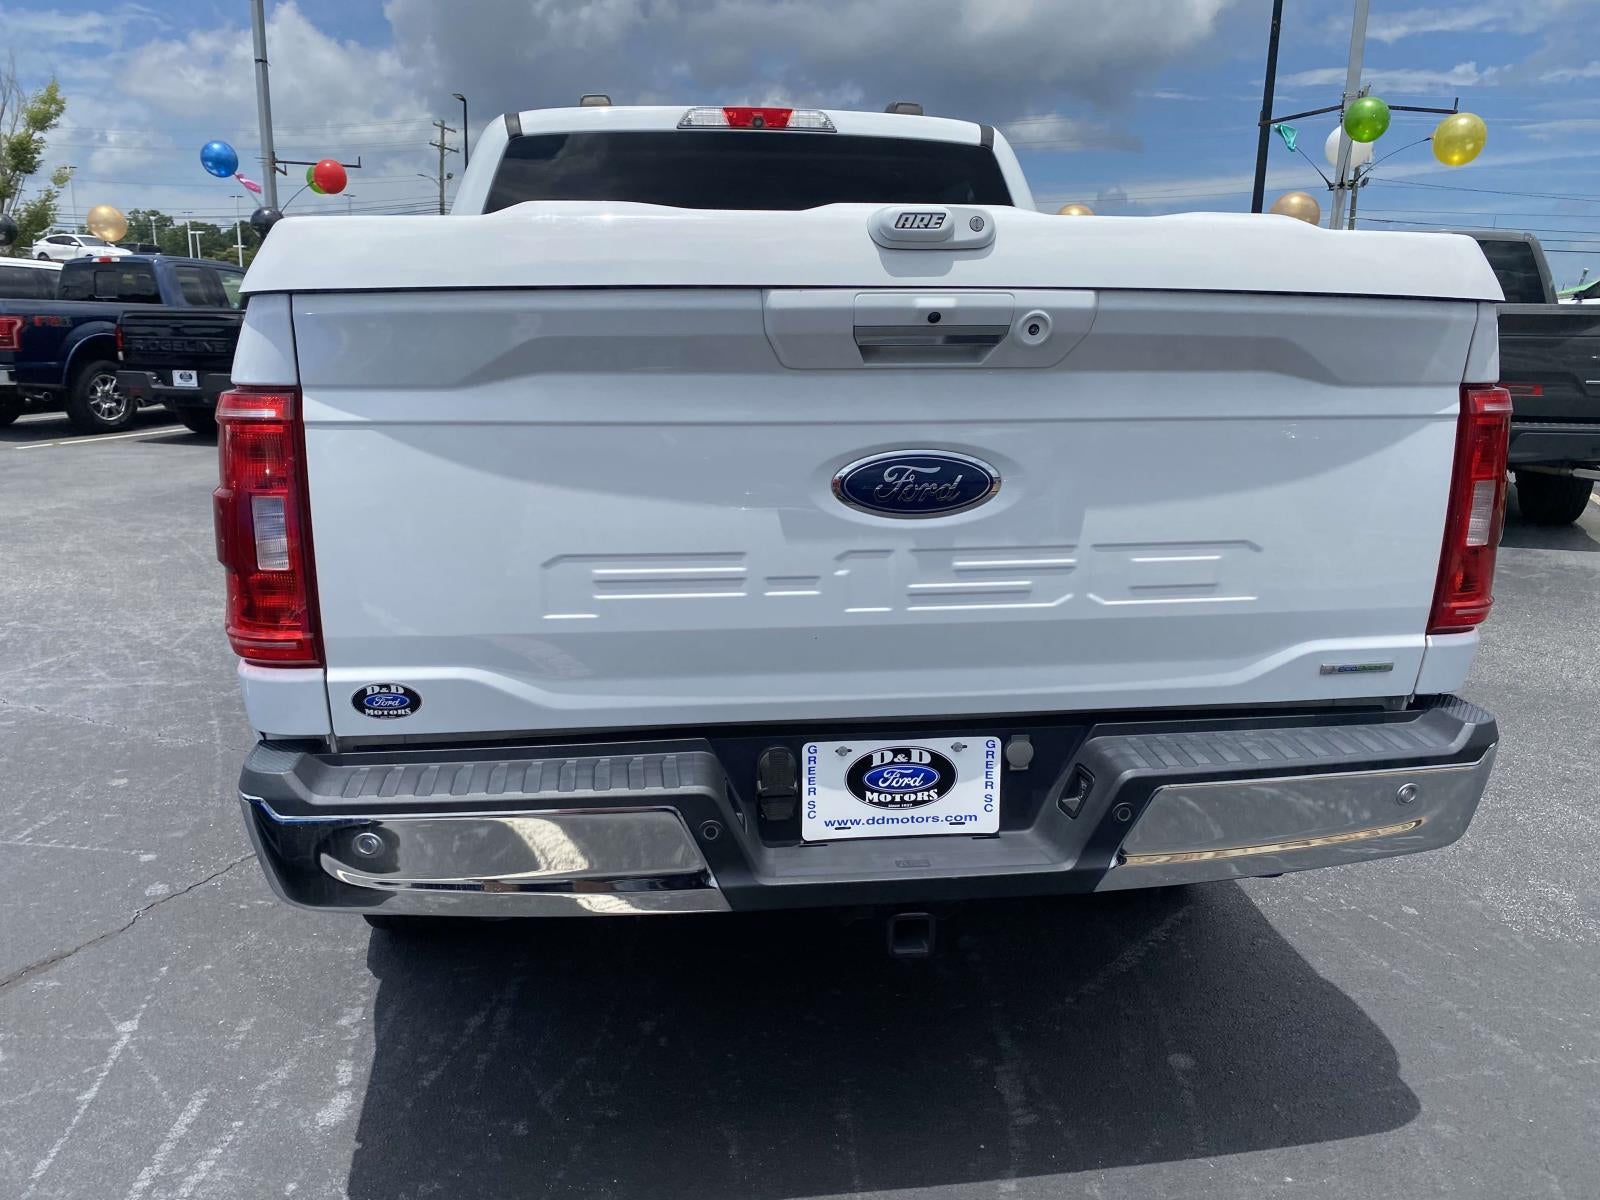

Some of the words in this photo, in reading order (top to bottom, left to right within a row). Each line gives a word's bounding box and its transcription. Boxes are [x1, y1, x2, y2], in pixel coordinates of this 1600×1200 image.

[895, 212, 946, 229] ARE
[873, 464, 964, 501] Ford
[540, 538, 1264, 620] F-150
[365, 684, 405, 696] D&D
[372, 695, 401, 707] Ford
[365, 707, 412, 716] MOTORS
[870, 748, 932, 768] D&D
[985, 739, 996, 790] GREER
[807, 745, 818, 796] GREER
[878, 768, 925, 787] Ford
[864, 788, 939, 803] MOTORS
[983, 793, 994, 813] SC
[807, 800, 817, 819] SC
[824, 814, 978, 827] www.ddmotors.com
